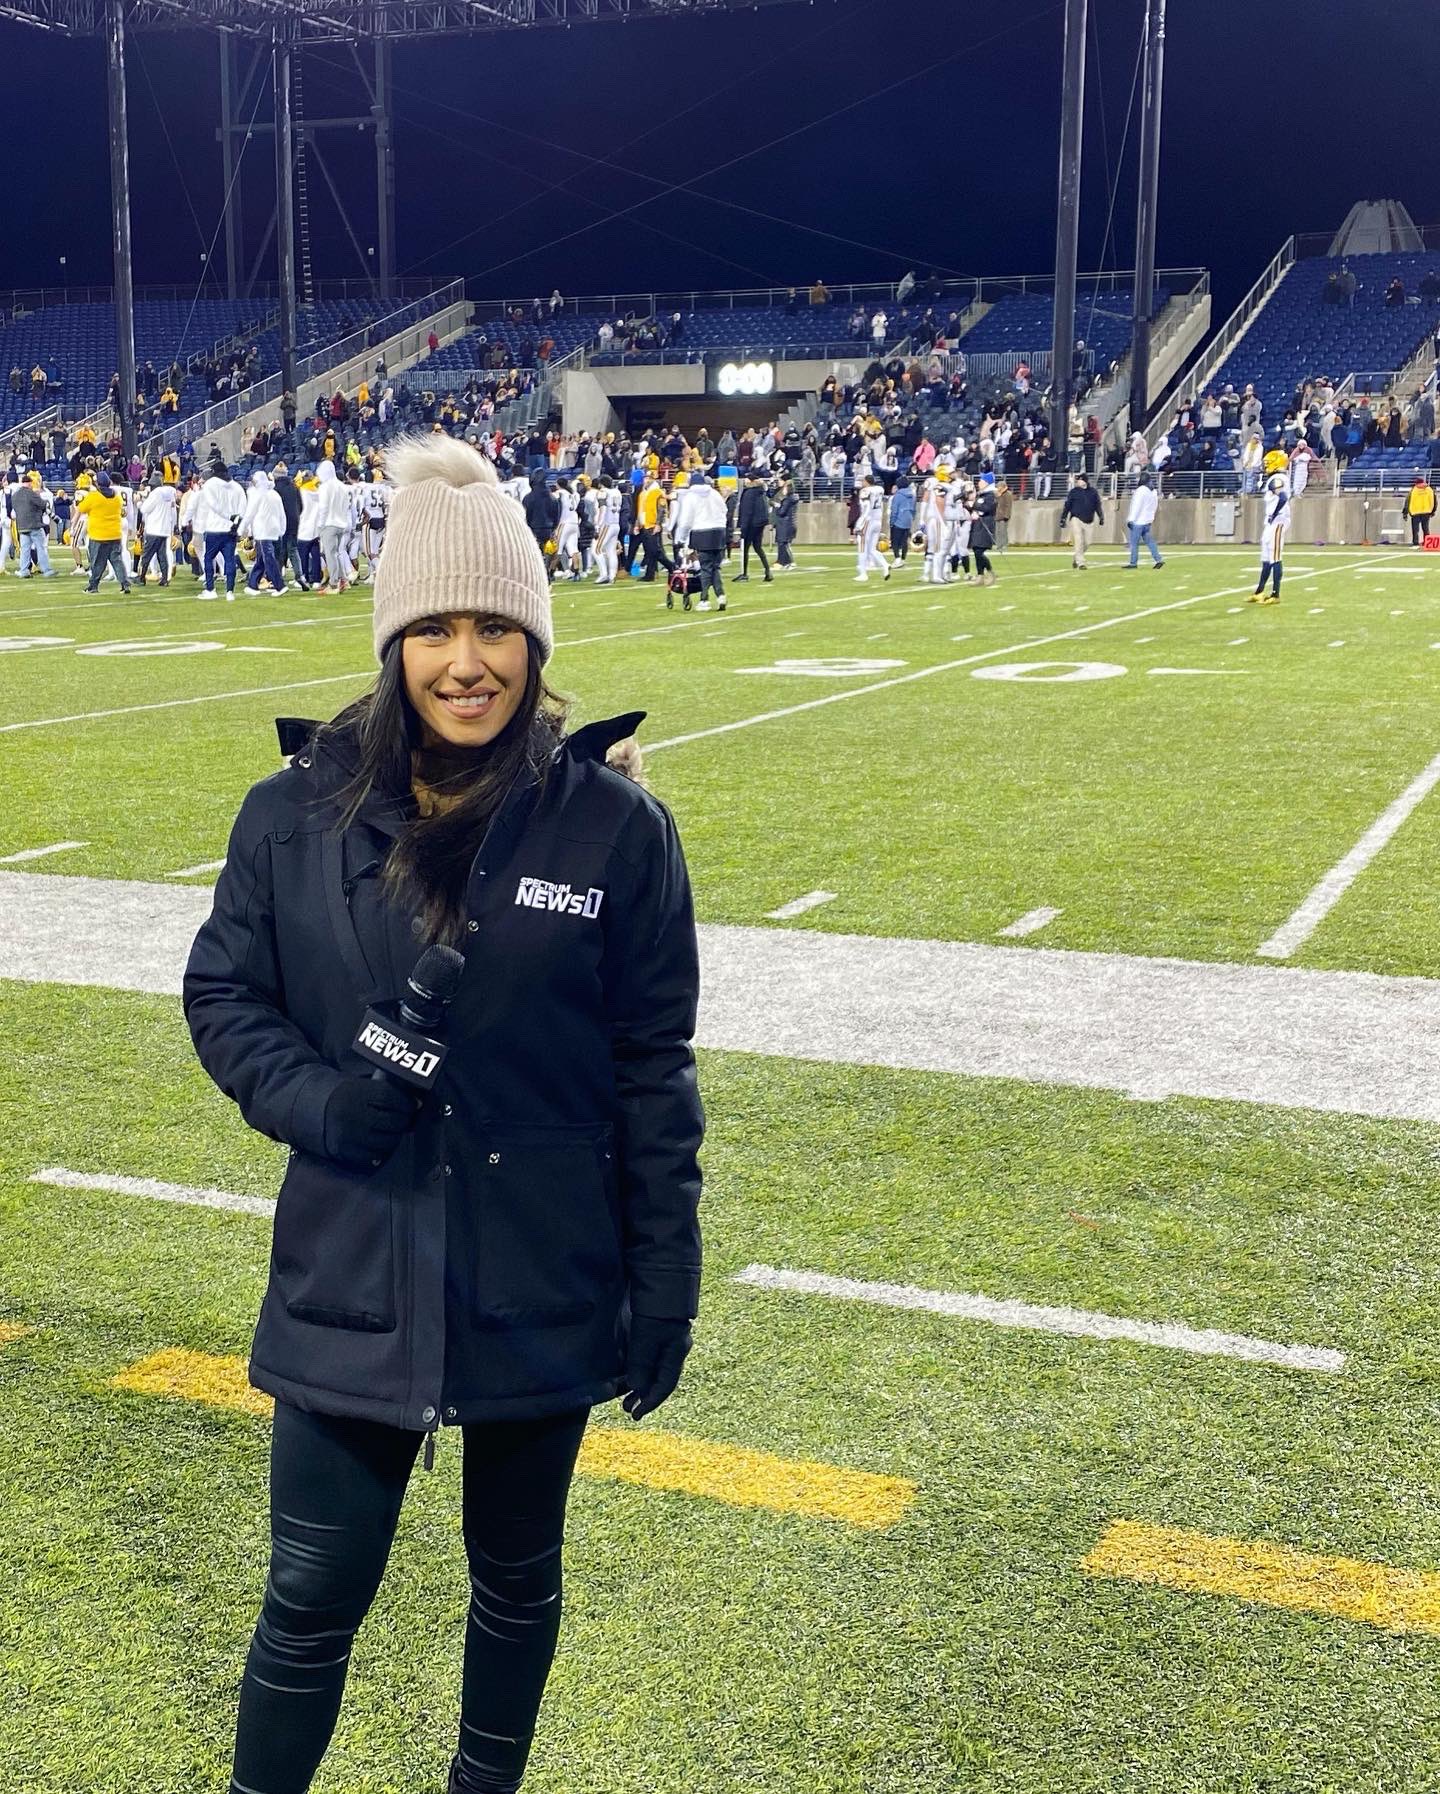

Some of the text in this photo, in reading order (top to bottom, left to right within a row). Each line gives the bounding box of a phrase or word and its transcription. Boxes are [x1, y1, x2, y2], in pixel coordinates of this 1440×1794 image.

[1425, 536, 1440, 549] 20
[519, 876, 571, 894] SPECTRUM
[367, 1021, 410, 1050] SPECTRUM
